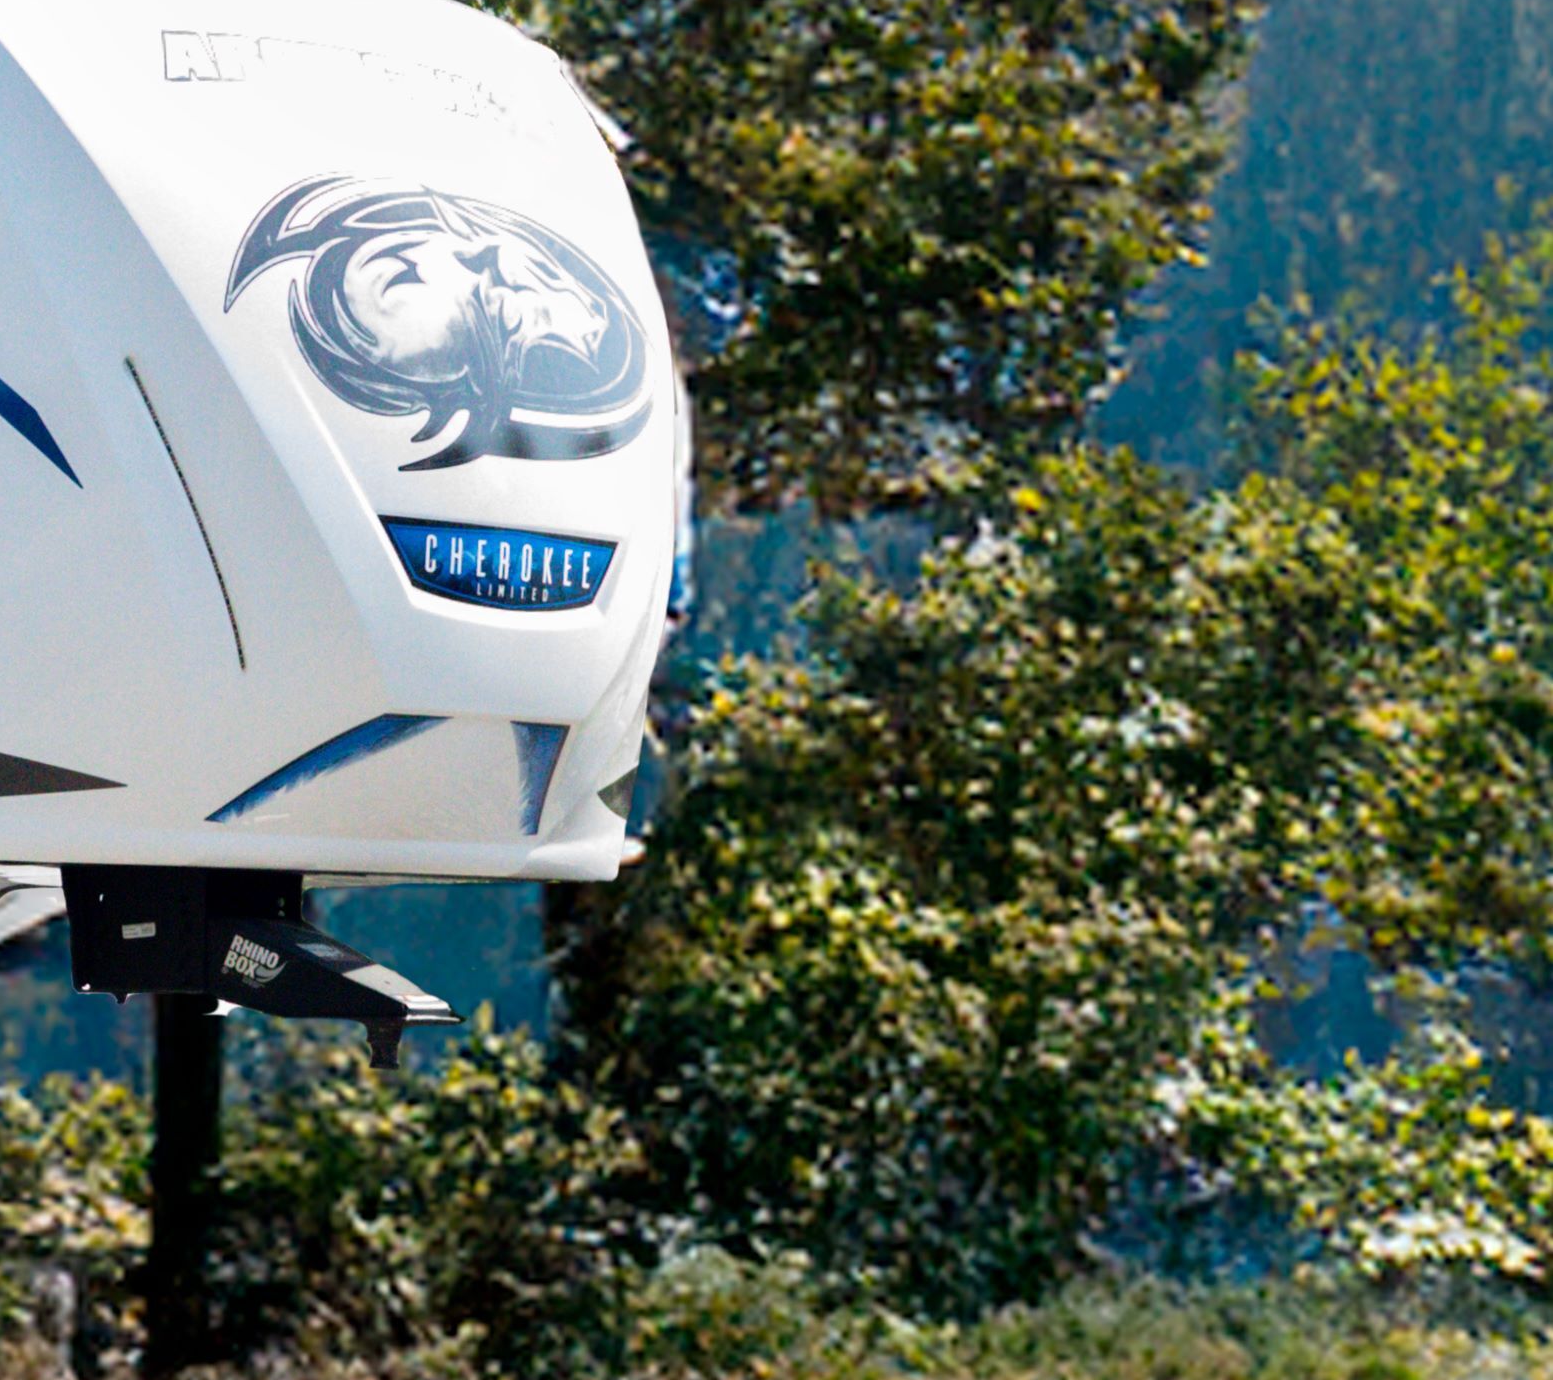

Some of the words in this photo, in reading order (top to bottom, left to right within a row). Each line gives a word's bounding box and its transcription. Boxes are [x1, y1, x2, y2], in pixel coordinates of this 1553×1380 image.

[424, 534, 591, 589] CHEROKEE
[476, 583, 549, 602] LIMITED
[224, 950, 259, 979] BOX
[230, 934, 280, 969] RHINO
